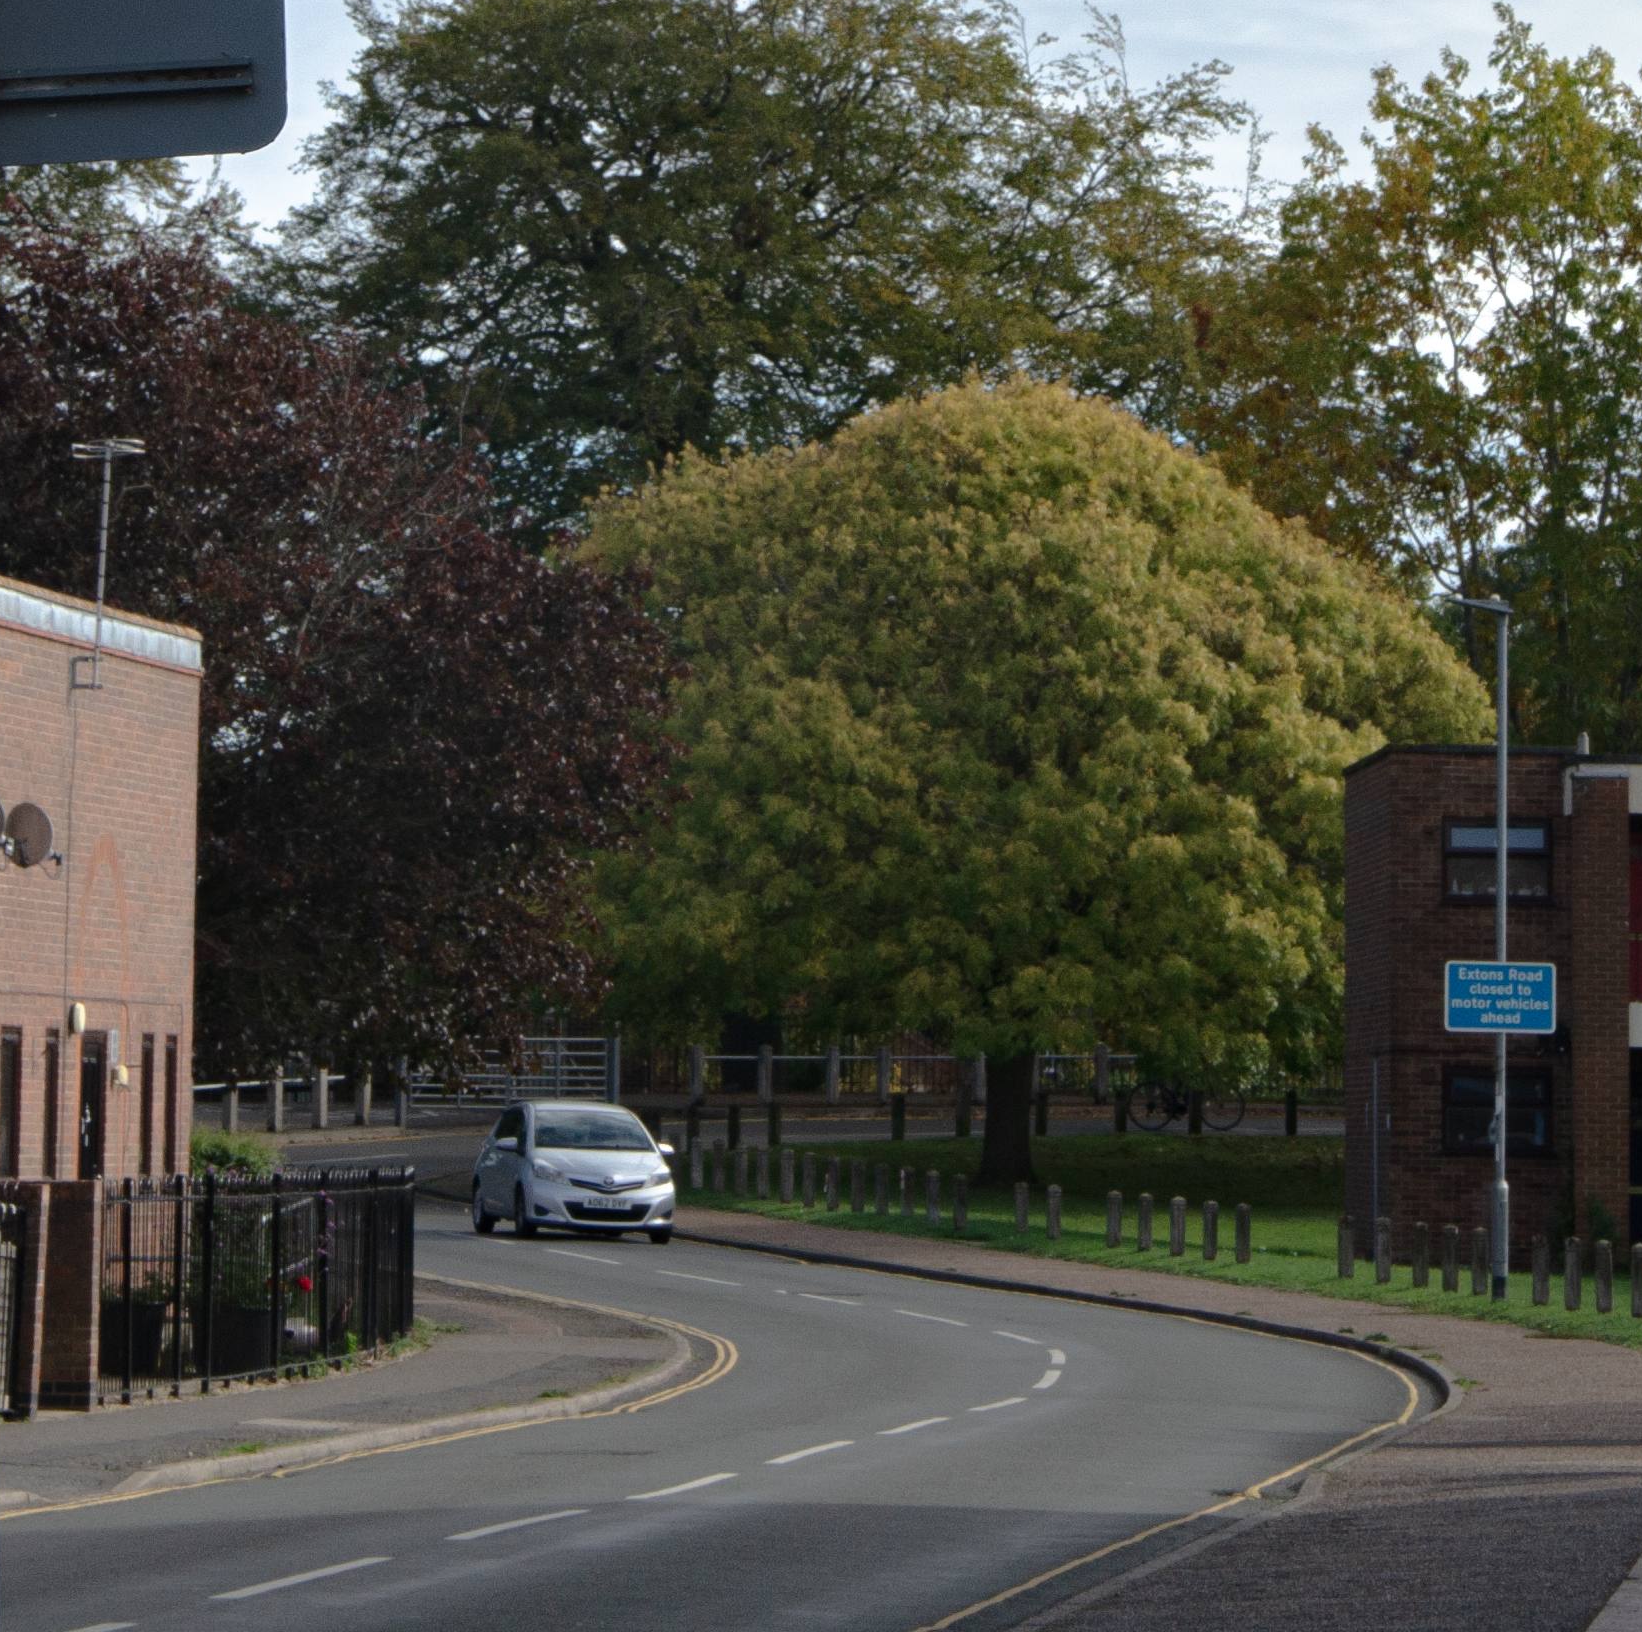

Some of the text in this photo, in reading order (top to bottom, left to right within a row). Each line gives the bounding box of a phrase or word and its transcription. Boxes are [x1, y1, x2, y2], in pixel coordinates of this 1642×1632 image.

[1458, 967, 1543, 982] Extons Road
[1469, 983, 1532, 996] closed to
[1451, 997, 1549, 1010] motor vehicles
[1480, 1012, 1521, 1024] ahead
